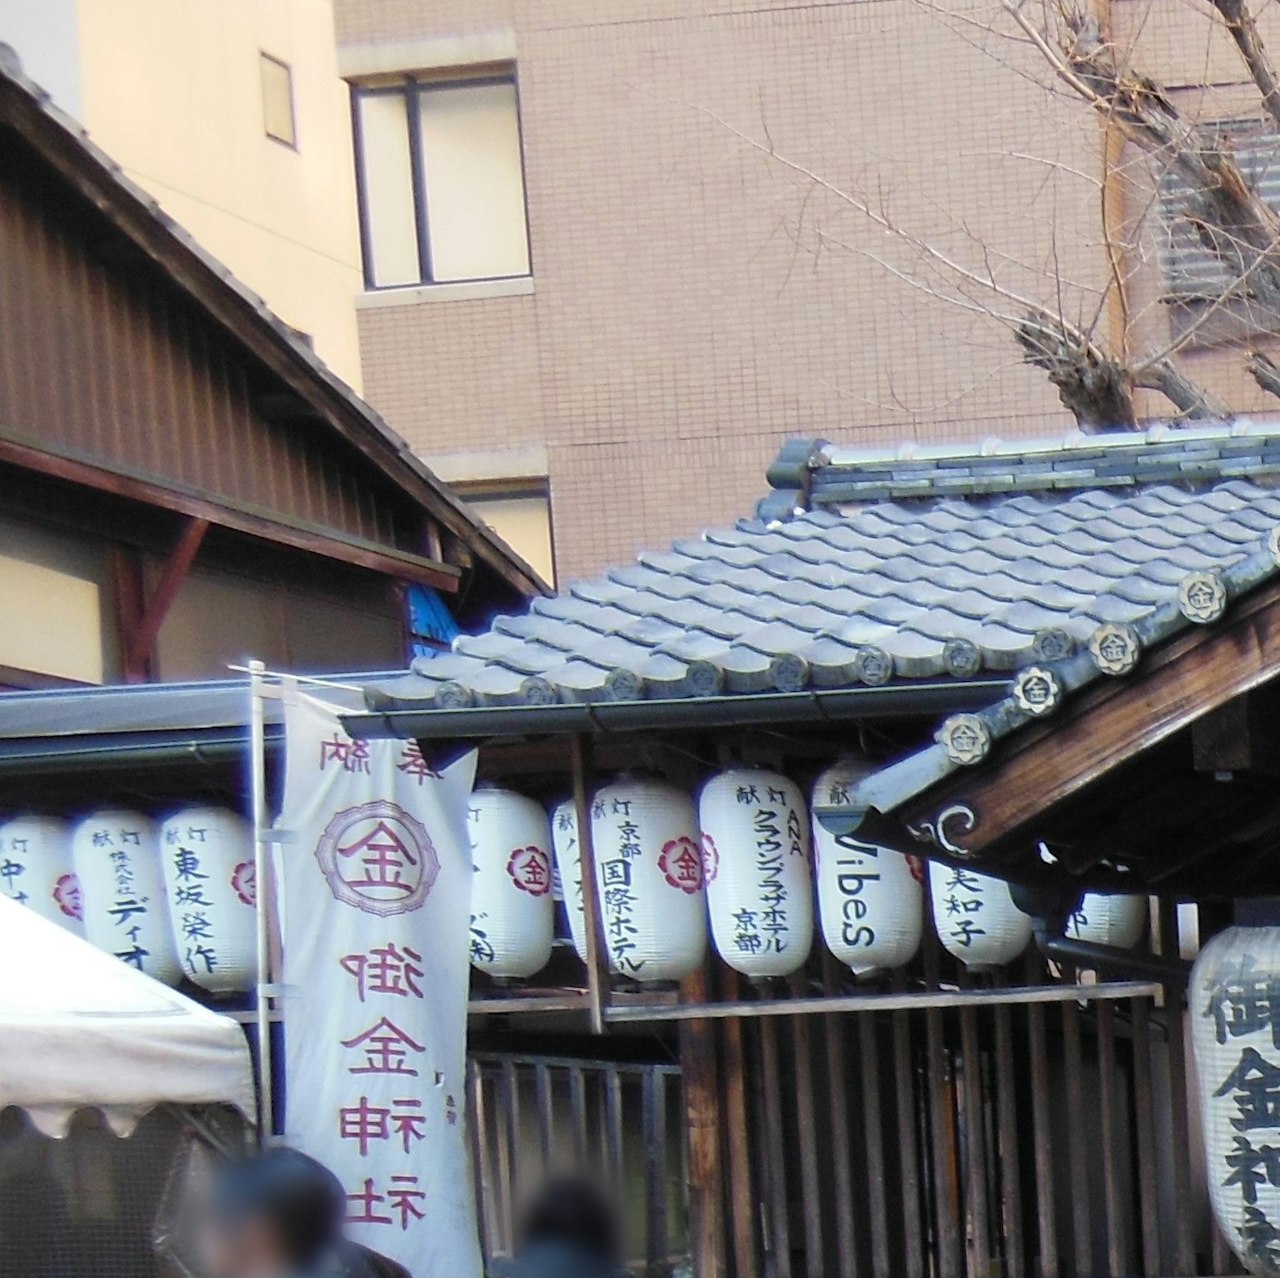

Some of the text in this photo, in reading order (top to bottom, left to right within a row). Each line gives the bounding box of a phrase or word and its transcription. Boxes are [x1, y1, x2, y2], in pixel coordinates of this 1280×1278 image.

[735, 784, 787, 807] 献灯
[786, 809, 804, 857] ANA
[519, 854, 547, 885] 金
[672, 846, 699, 882] 金
[753, 809, 790, 953] クラウンプラザホテル
[601, 820, 646, 973] 京都 国際ホテル
[731, 907, 762, 955] 京都
